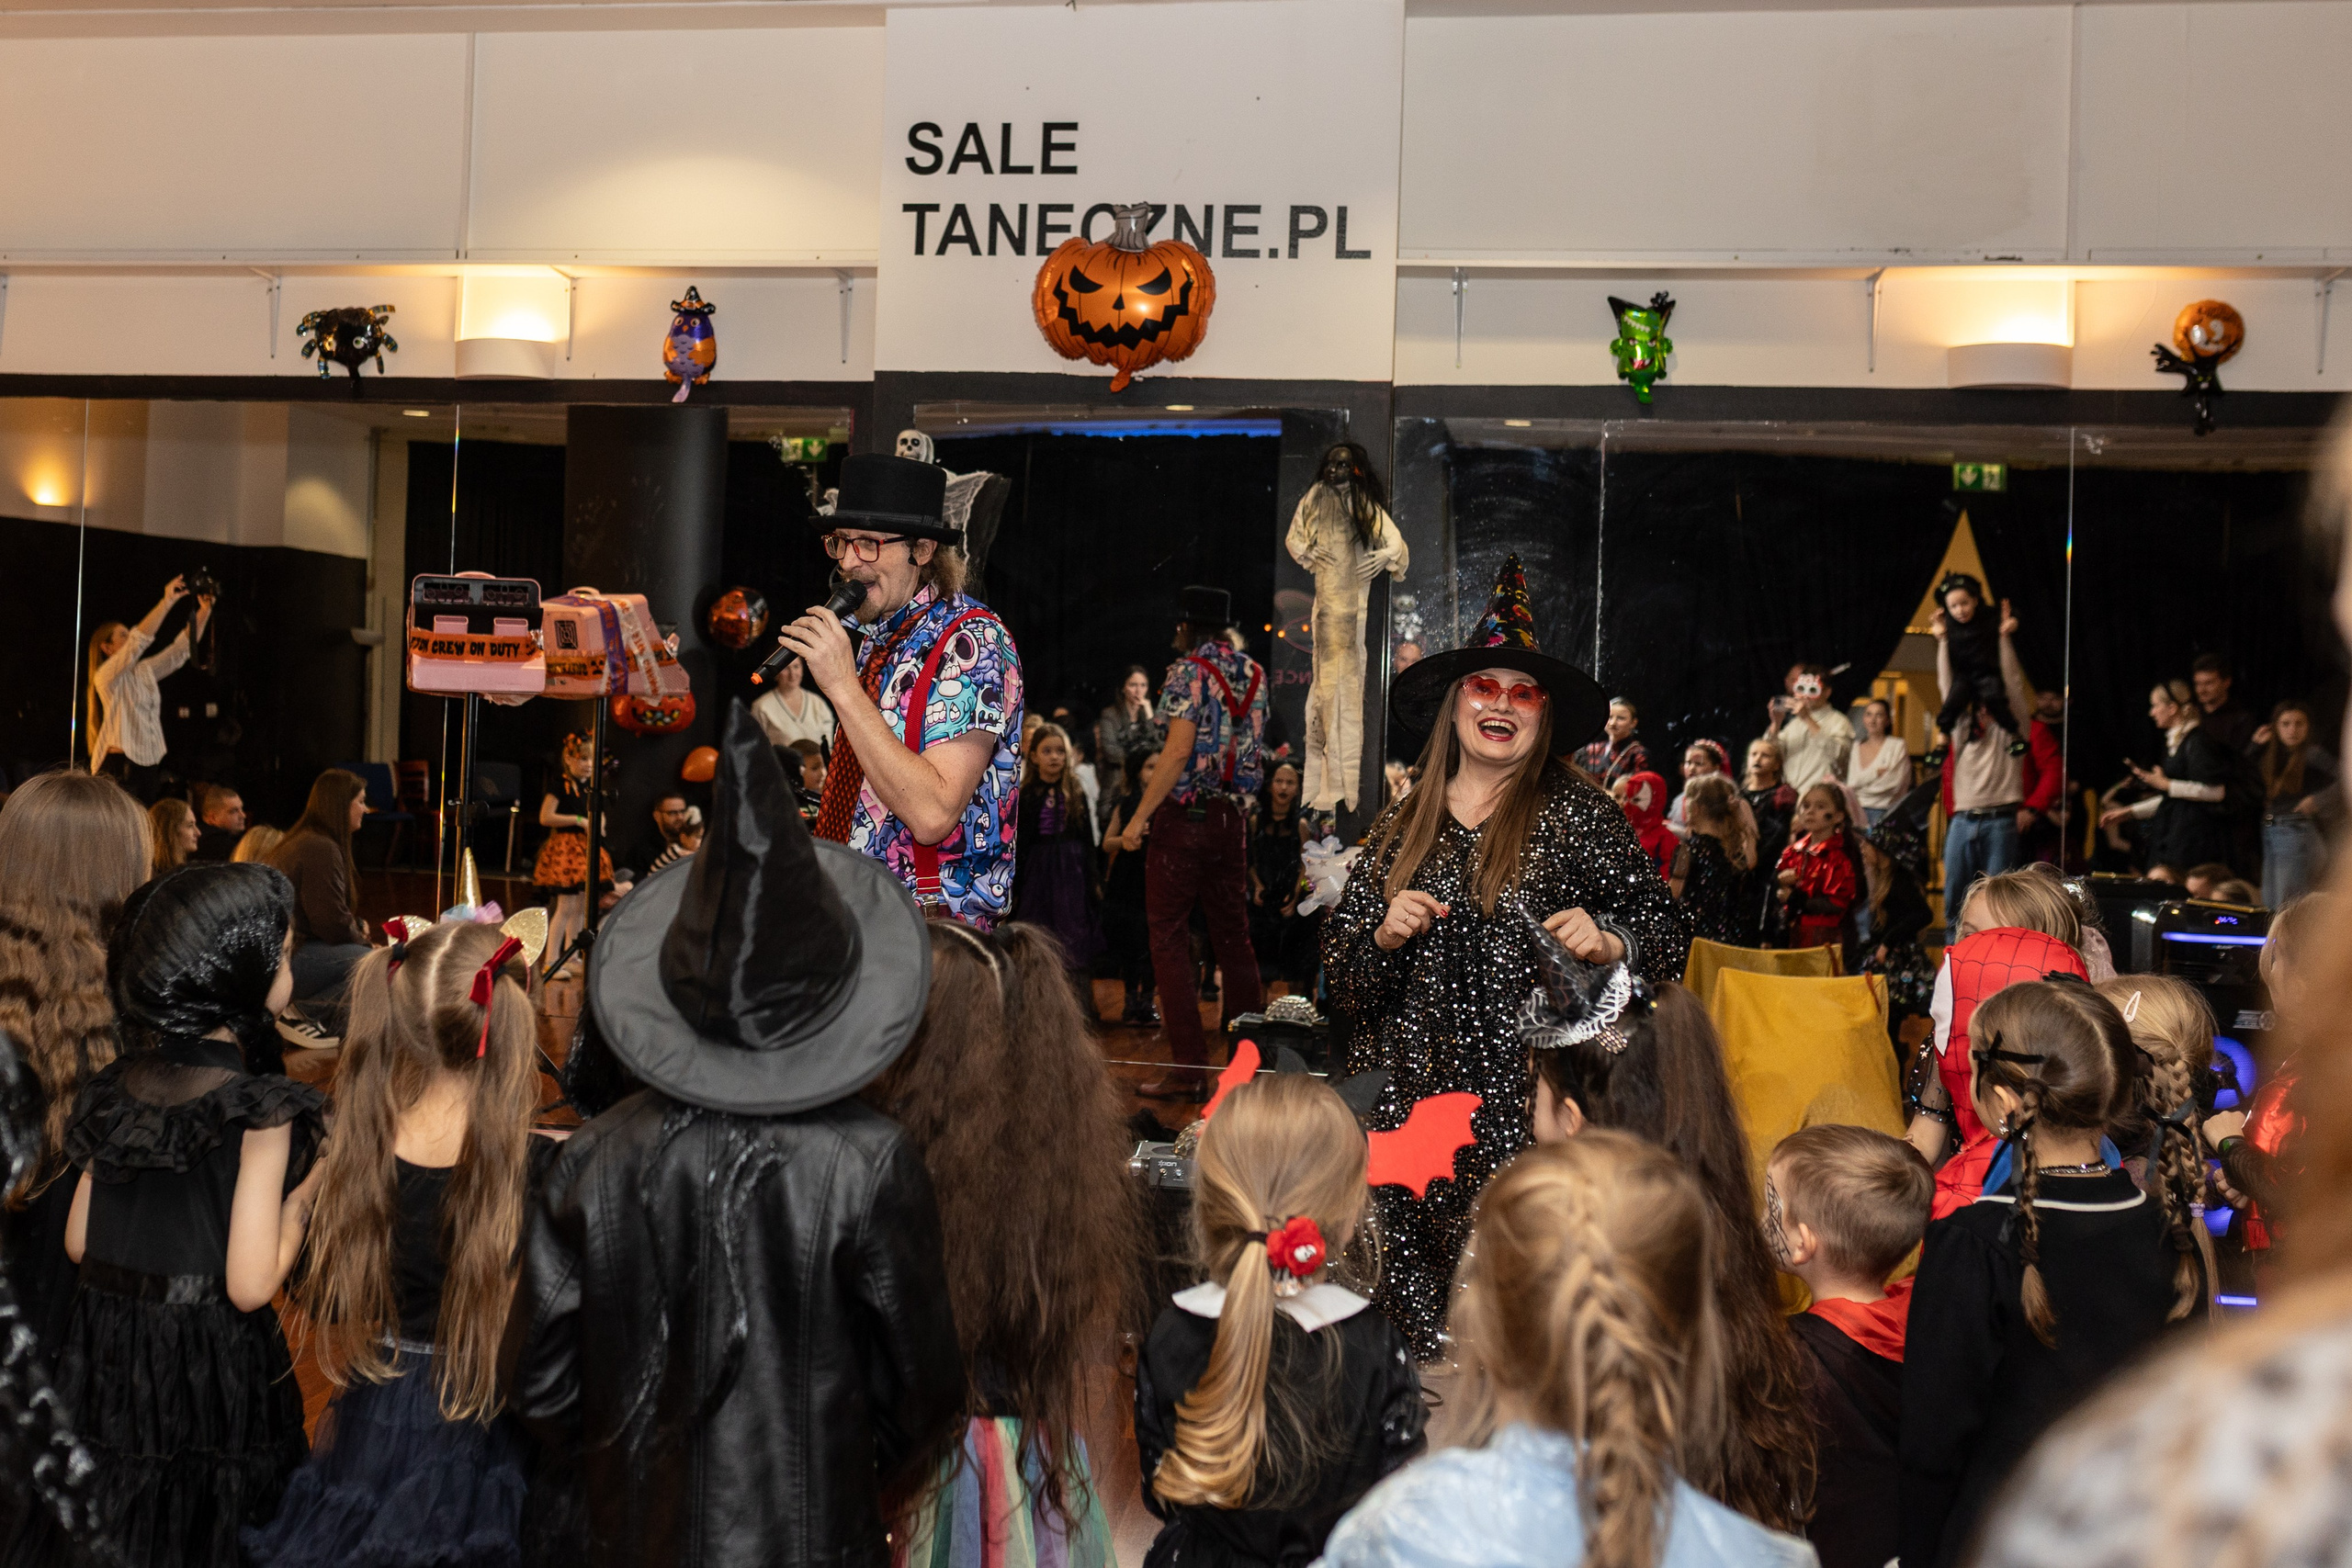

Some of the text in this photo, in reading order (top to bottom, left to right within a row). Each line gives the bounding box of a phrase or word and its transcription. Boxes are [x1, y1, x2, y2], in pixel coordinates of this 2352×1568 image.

[904, 121, 1079, 175] SALE
[431, 639, 466, 656] CREW
[469, 641, 485, 657] ON
[490, 642, 521, 659] DUTY
